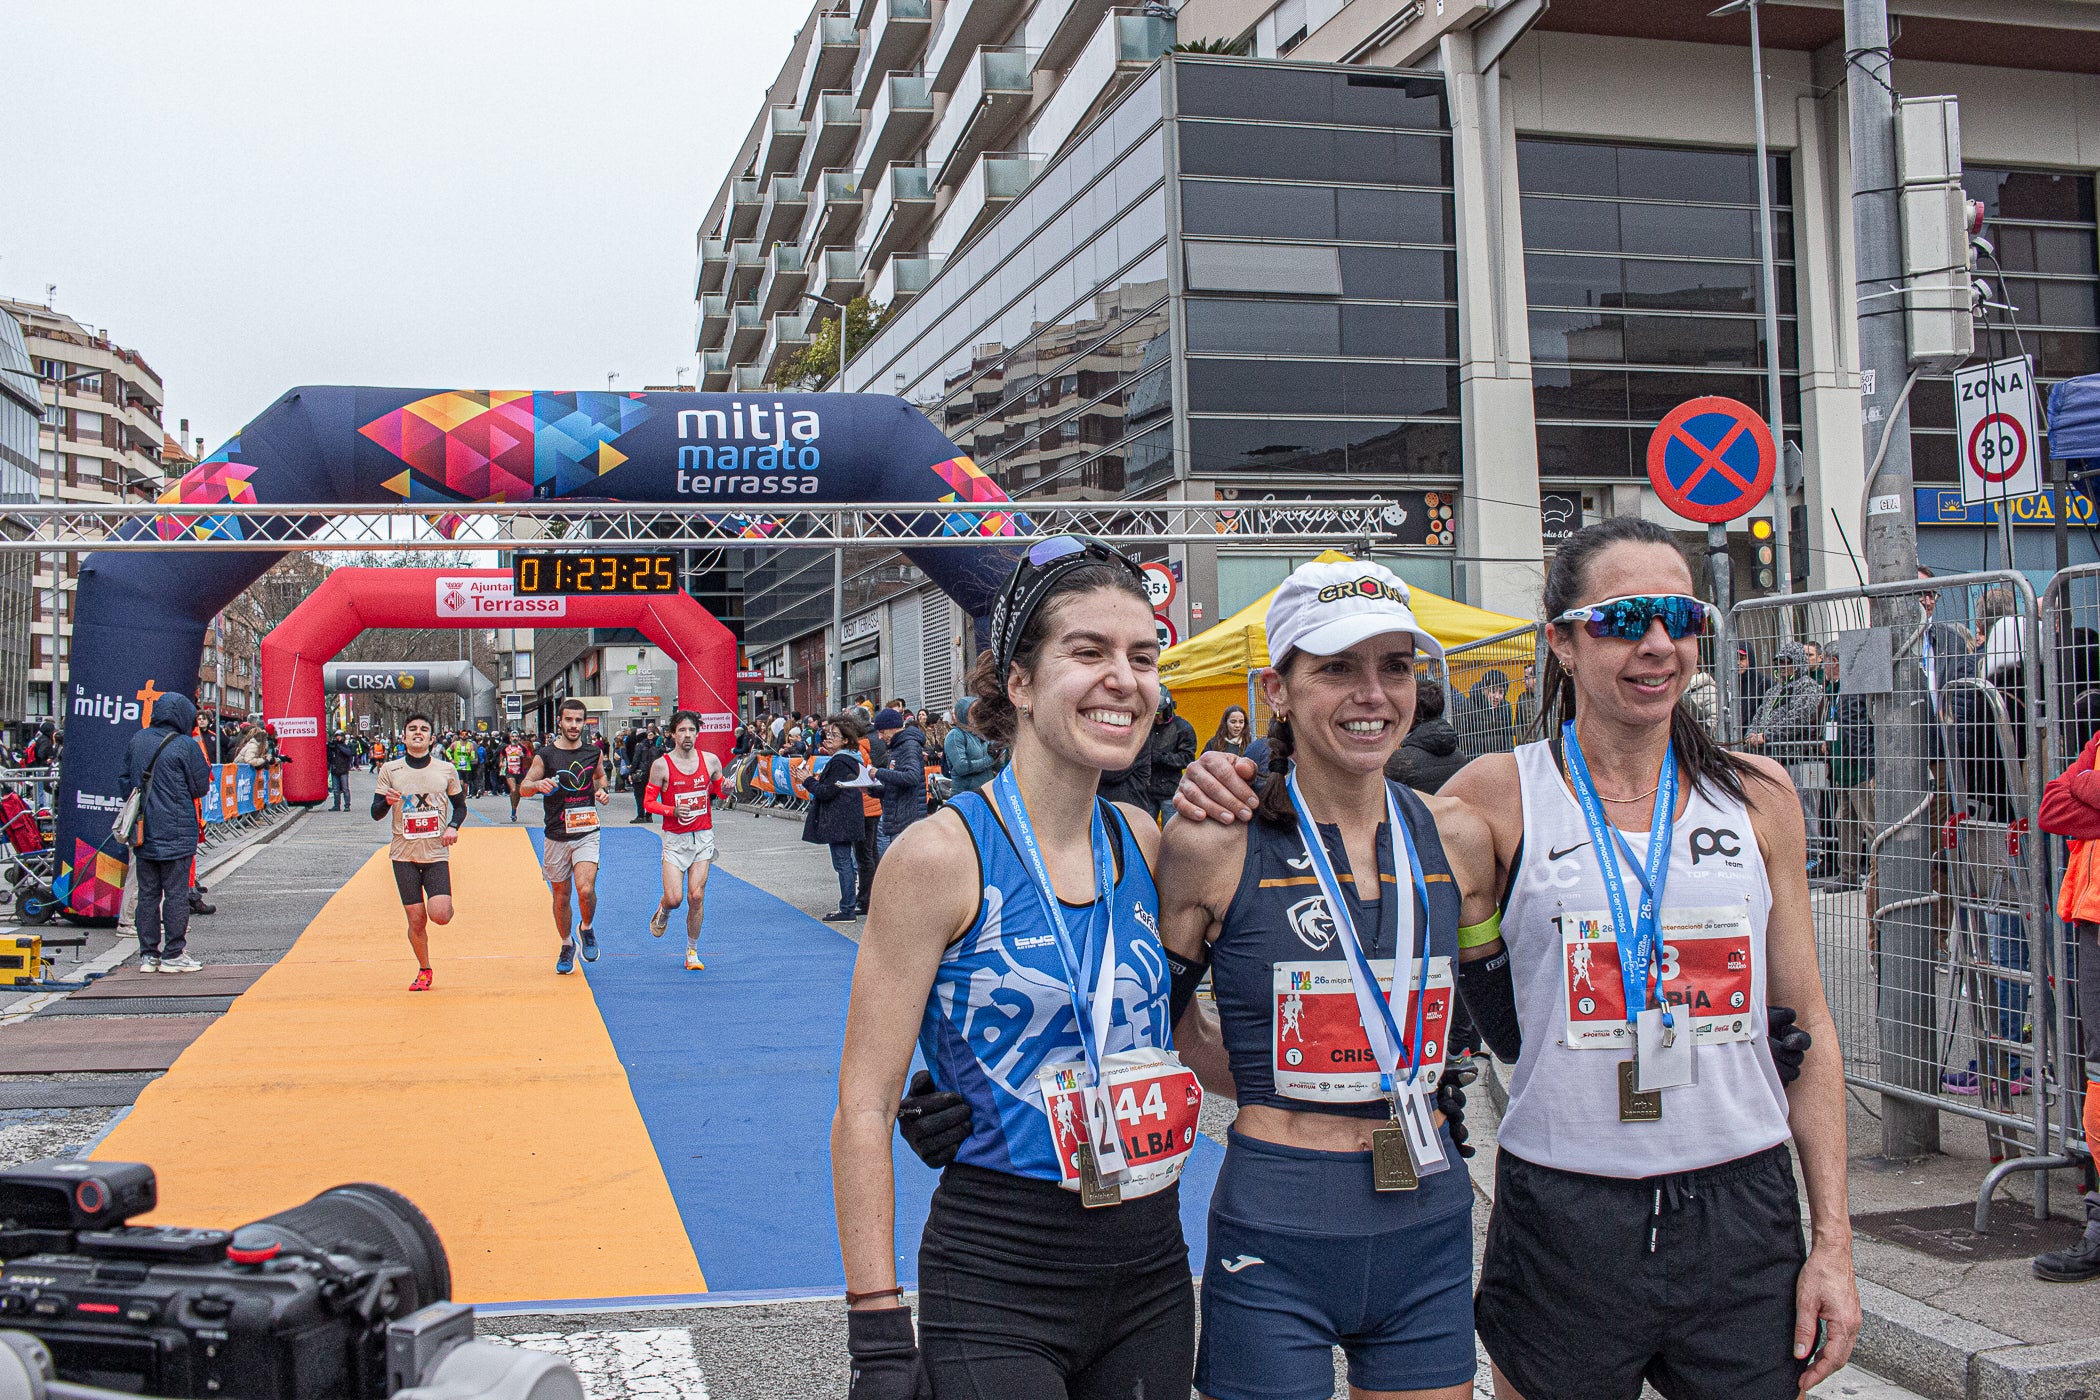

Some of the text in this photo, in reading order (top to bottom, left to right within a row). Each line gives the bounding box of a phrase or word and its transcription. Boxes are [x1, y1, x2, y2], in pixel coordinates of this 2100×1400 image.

[1962, 373, 2023, 402] ZONA
[678, 402, 820, 451] mitja
[678, 437, 820, 470] marató
[1981, 435, 2014, 460] 30
[677, 470, 818, 493] terrassa
[471, 582, 513, 592] Ajunta
[521, 557, 672, 591] 01:23:25
[471, 596, 559, 612] Terrassa
[76, 684, 84, 695] la
[346, 675, 396, 689] CIRSA
[74, 693, 140, 725] mitja
[278, 726, 316, 735] Terrassa
[688, 797, 698, 805] 34
[1010, 795, 1029, 834] terrassa
[1584, 796, 1599, 826] marató
[1655, 791, 1670, 840] internacional
[415, 818, 428, 827] 56
[1025, 835, 1034, 847] de
[1594, 826, 1616, 879] internacional
[1652, 842, 1661, 873] marató
[1725, 860, 1743, 869] team
[1028, 848, 1056, 908] internacional
[1609, 880, 1618, 891] de
[1602, 925, 1615, 933] 26
[1661, 923, 1703, 931] nternacional
[1713, 921, 1739, 929] terrassa
[1612, 894, 1627, 933] terrassa
[1650, 945, 1681, 981] 8
[1314, 976, 1329, 984] 26a
[1330, 976, 1347, 984] mitja
[1130, 1061, 1167, 1071] internaciona
[1116, 1083, 1167, 1126] 44
[1094, 1097, 1115, 1155] 2
[1406, 1094, 1428, 1148] 1
[1121, 1129, 1174, 1160] ALBA
